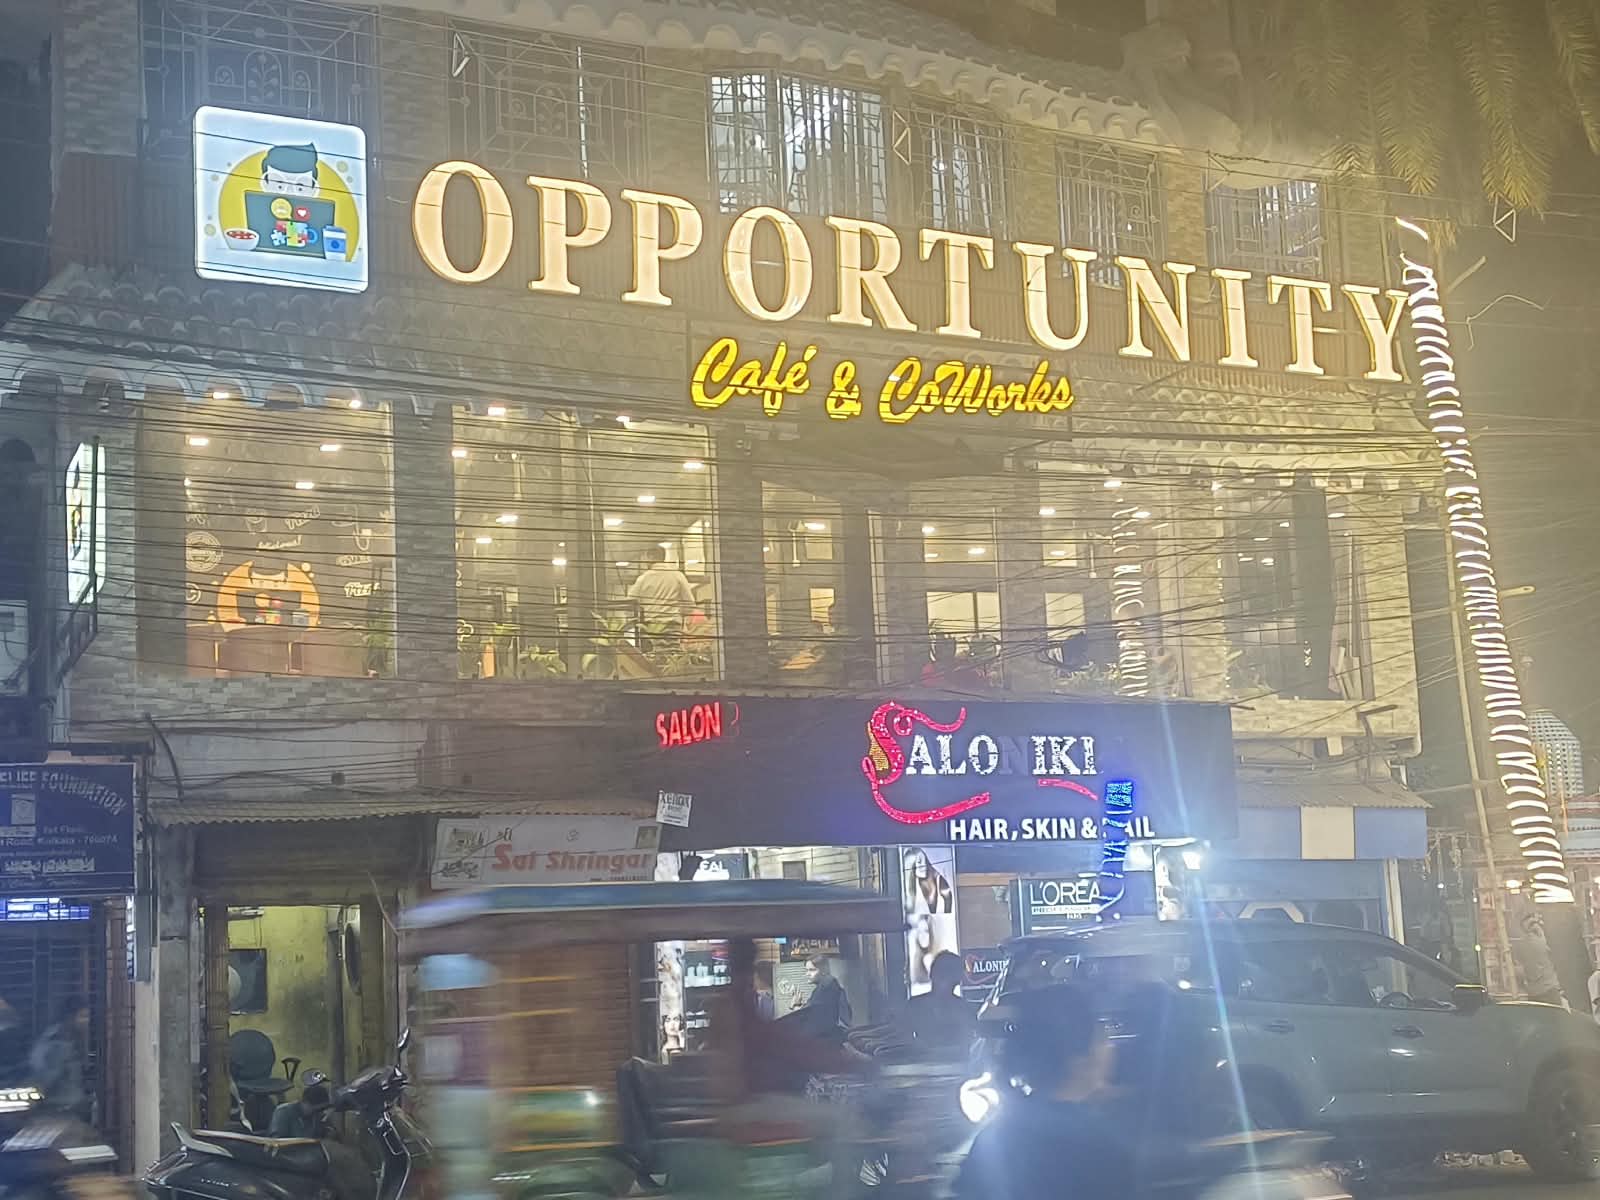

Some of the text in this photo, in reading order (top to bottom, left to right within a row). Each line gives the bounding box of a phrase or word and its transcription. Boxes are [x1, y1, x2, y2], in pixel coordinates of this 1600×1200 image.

[412, 160, 1409, 382] OPPORTUNITY
[689, 337, 1074, 424] Café & CoWorks
[656, 702, 721, 746] SALON
[1080, 816, 1098, 839] &
[1030, 880, 1102, 905] L'ORÉA
